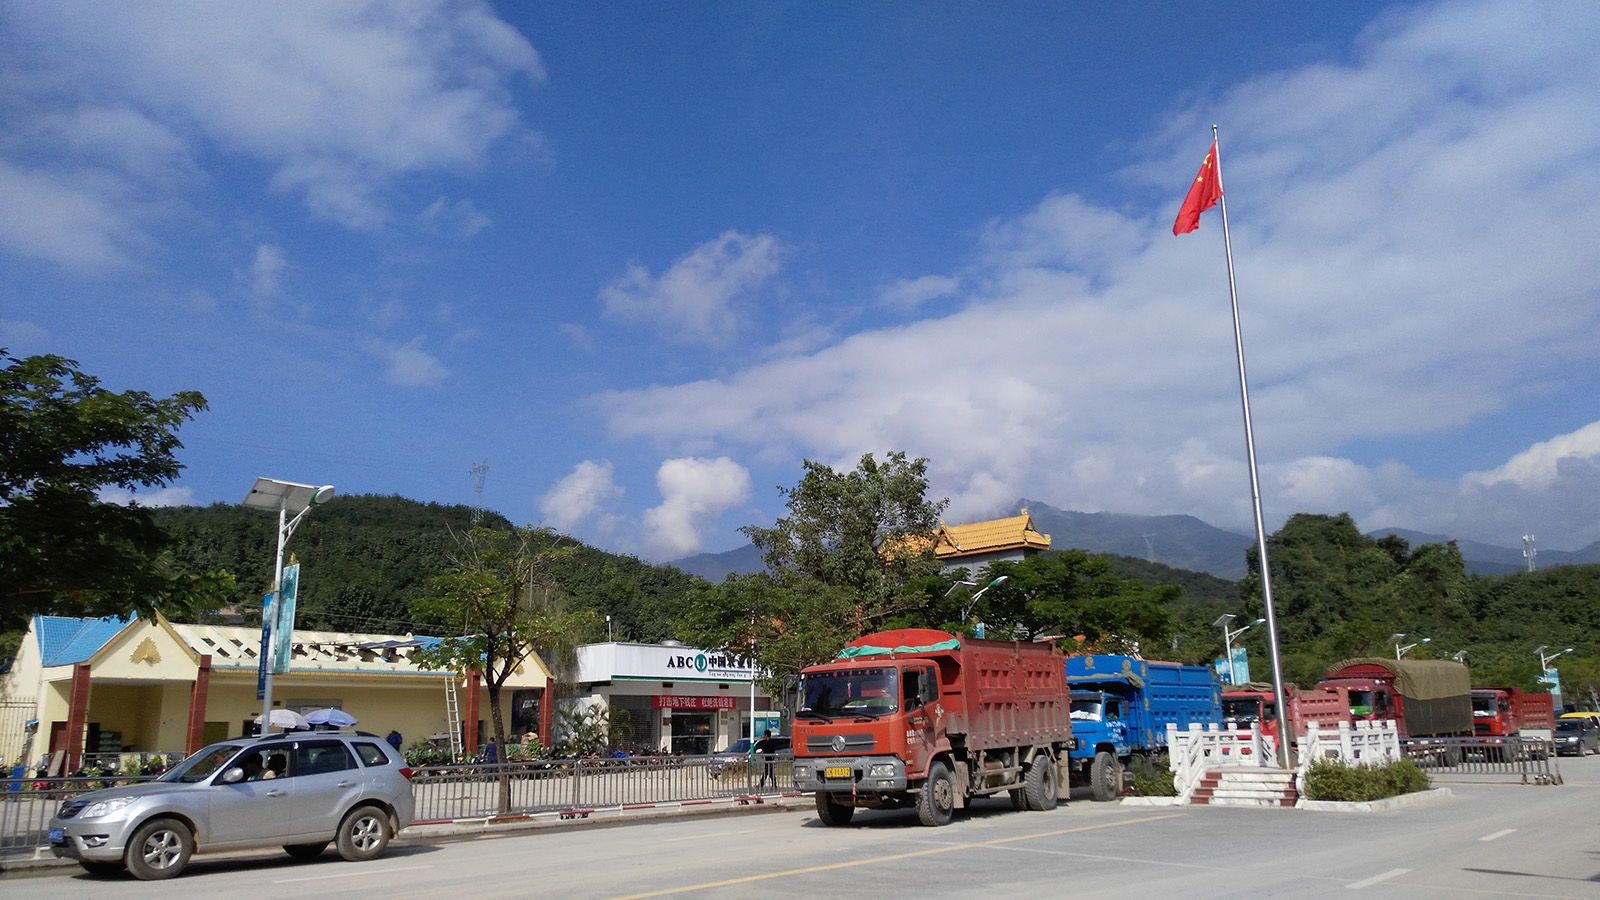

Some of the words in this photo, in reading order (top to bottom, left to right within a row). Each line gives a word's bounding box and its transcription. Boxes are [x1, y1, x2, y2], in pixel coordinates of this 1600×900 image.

[667, 656, 694, 668] ABC
[659, 697, 697, 708] 打击地下钱庄
